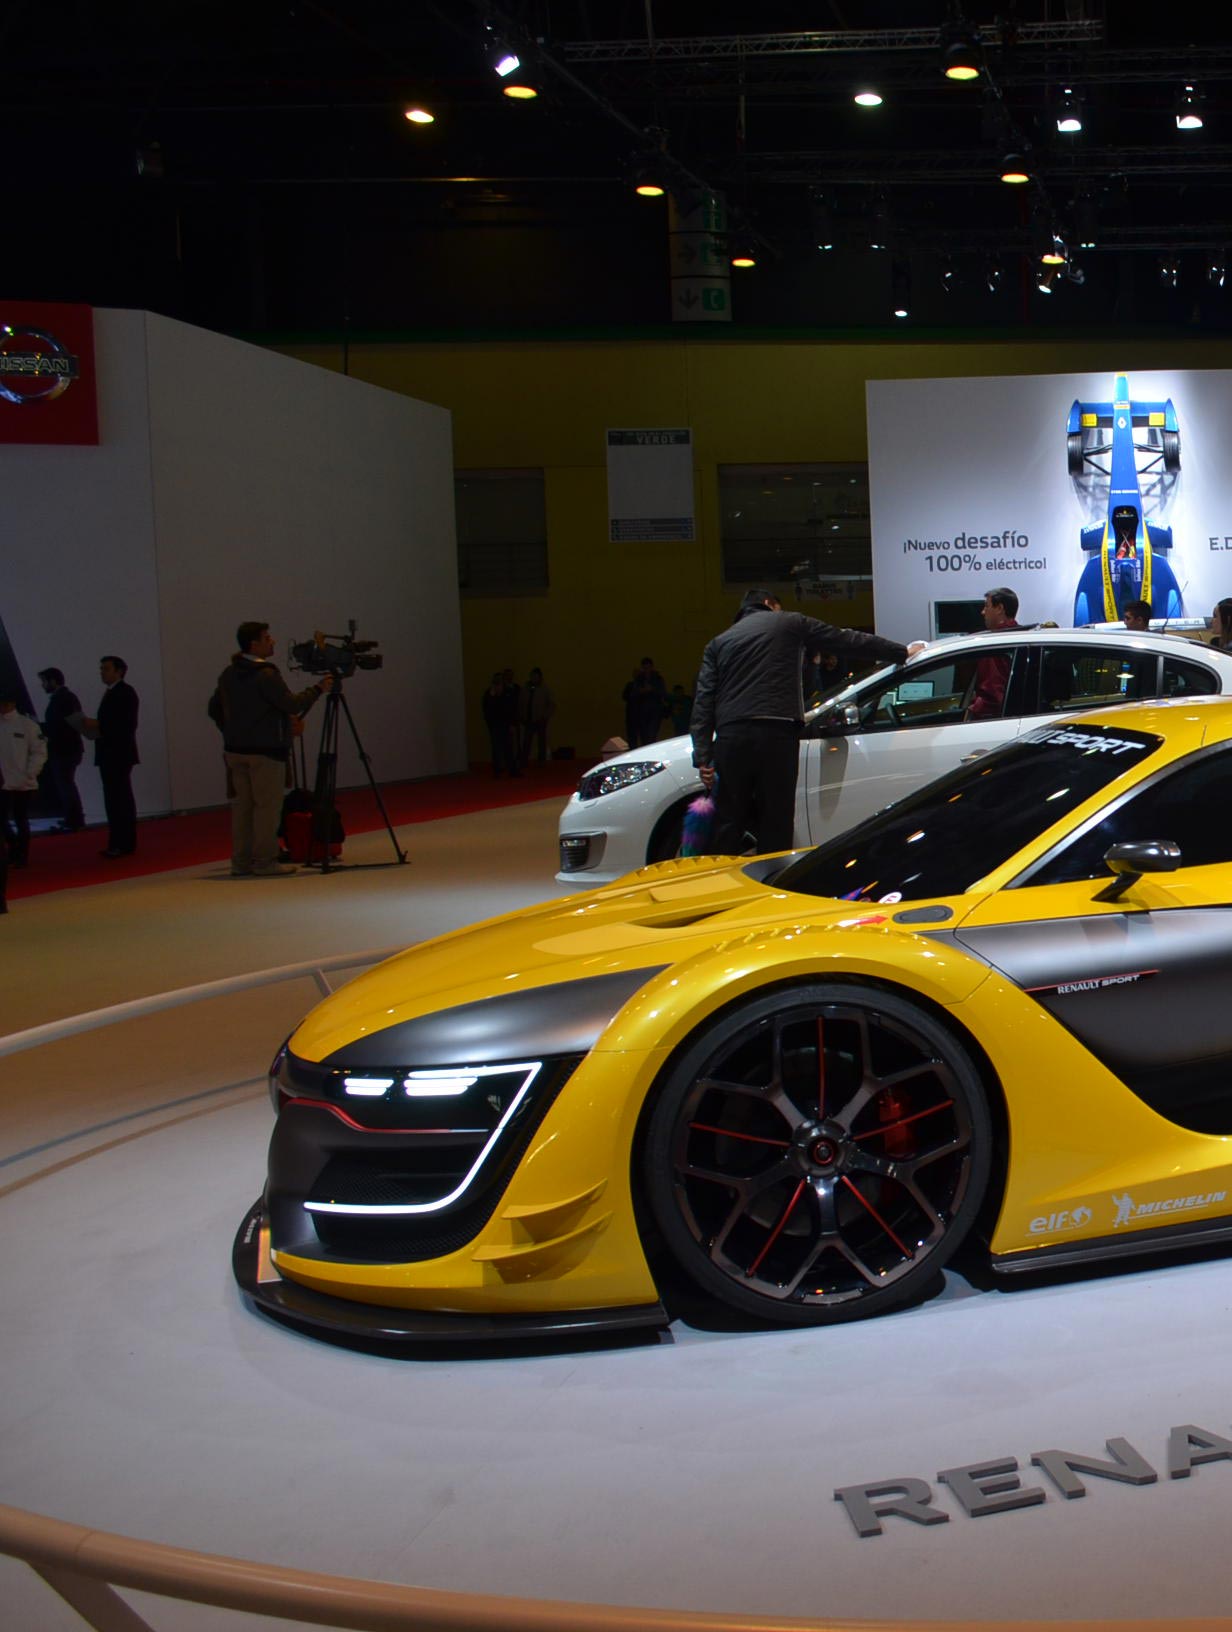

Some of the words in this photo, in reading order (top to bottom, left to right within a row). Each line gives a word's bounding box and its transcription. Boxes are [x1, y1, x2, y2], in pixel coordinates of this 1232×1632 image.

[903, 539, 951, 553] ¡Nuevo
[954, 530, 1030, 549] desafío
[924, 553, 982, 572] 100%
[1047, 731, 1146, 755] SPORT
[1057, 980, 1100, 994] RENAULT
[1101, 974, 1140, 987] SPORT
[1136, 1191, 1227, 1215] MICHELIN
[1029, 1210, 1069, 1233] elf
